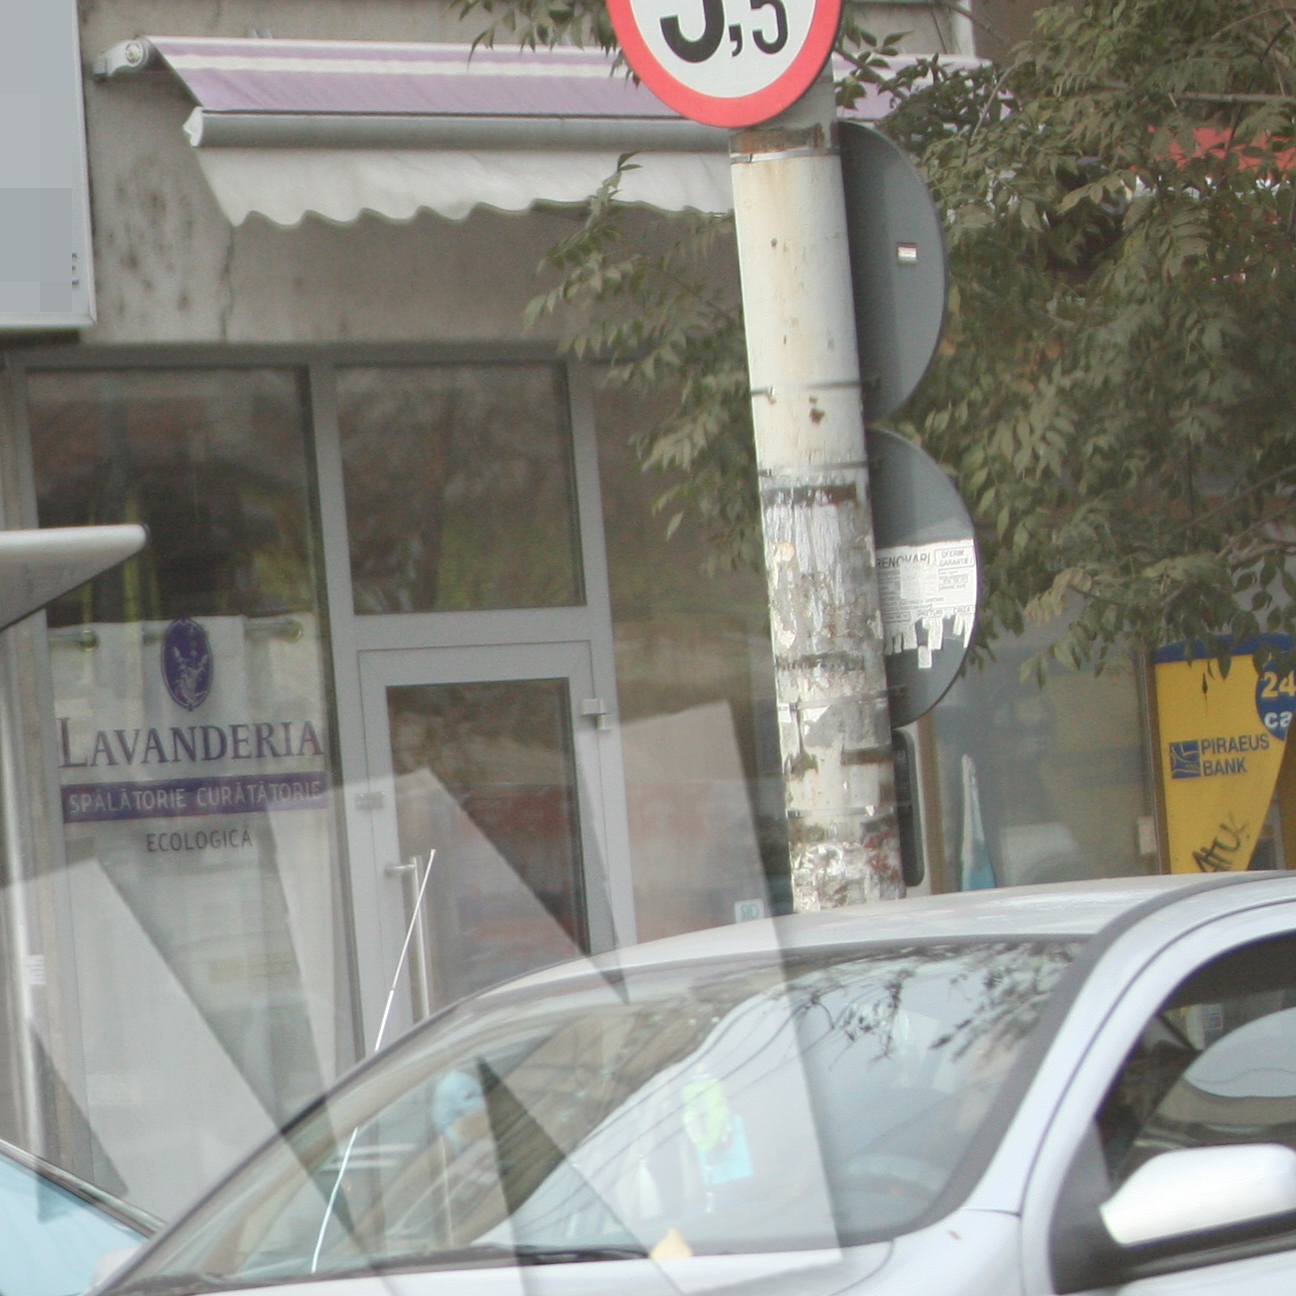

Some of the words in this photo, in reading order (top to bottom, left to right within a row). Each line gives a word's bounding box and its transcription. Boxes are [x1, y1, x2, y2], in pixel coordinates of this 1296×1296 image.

[56, 717, 325, 769] LAVANDERIA
[1201, 734, 1270, 755] PIRAEUS
[1203, 757, 1248, 777] BANK
